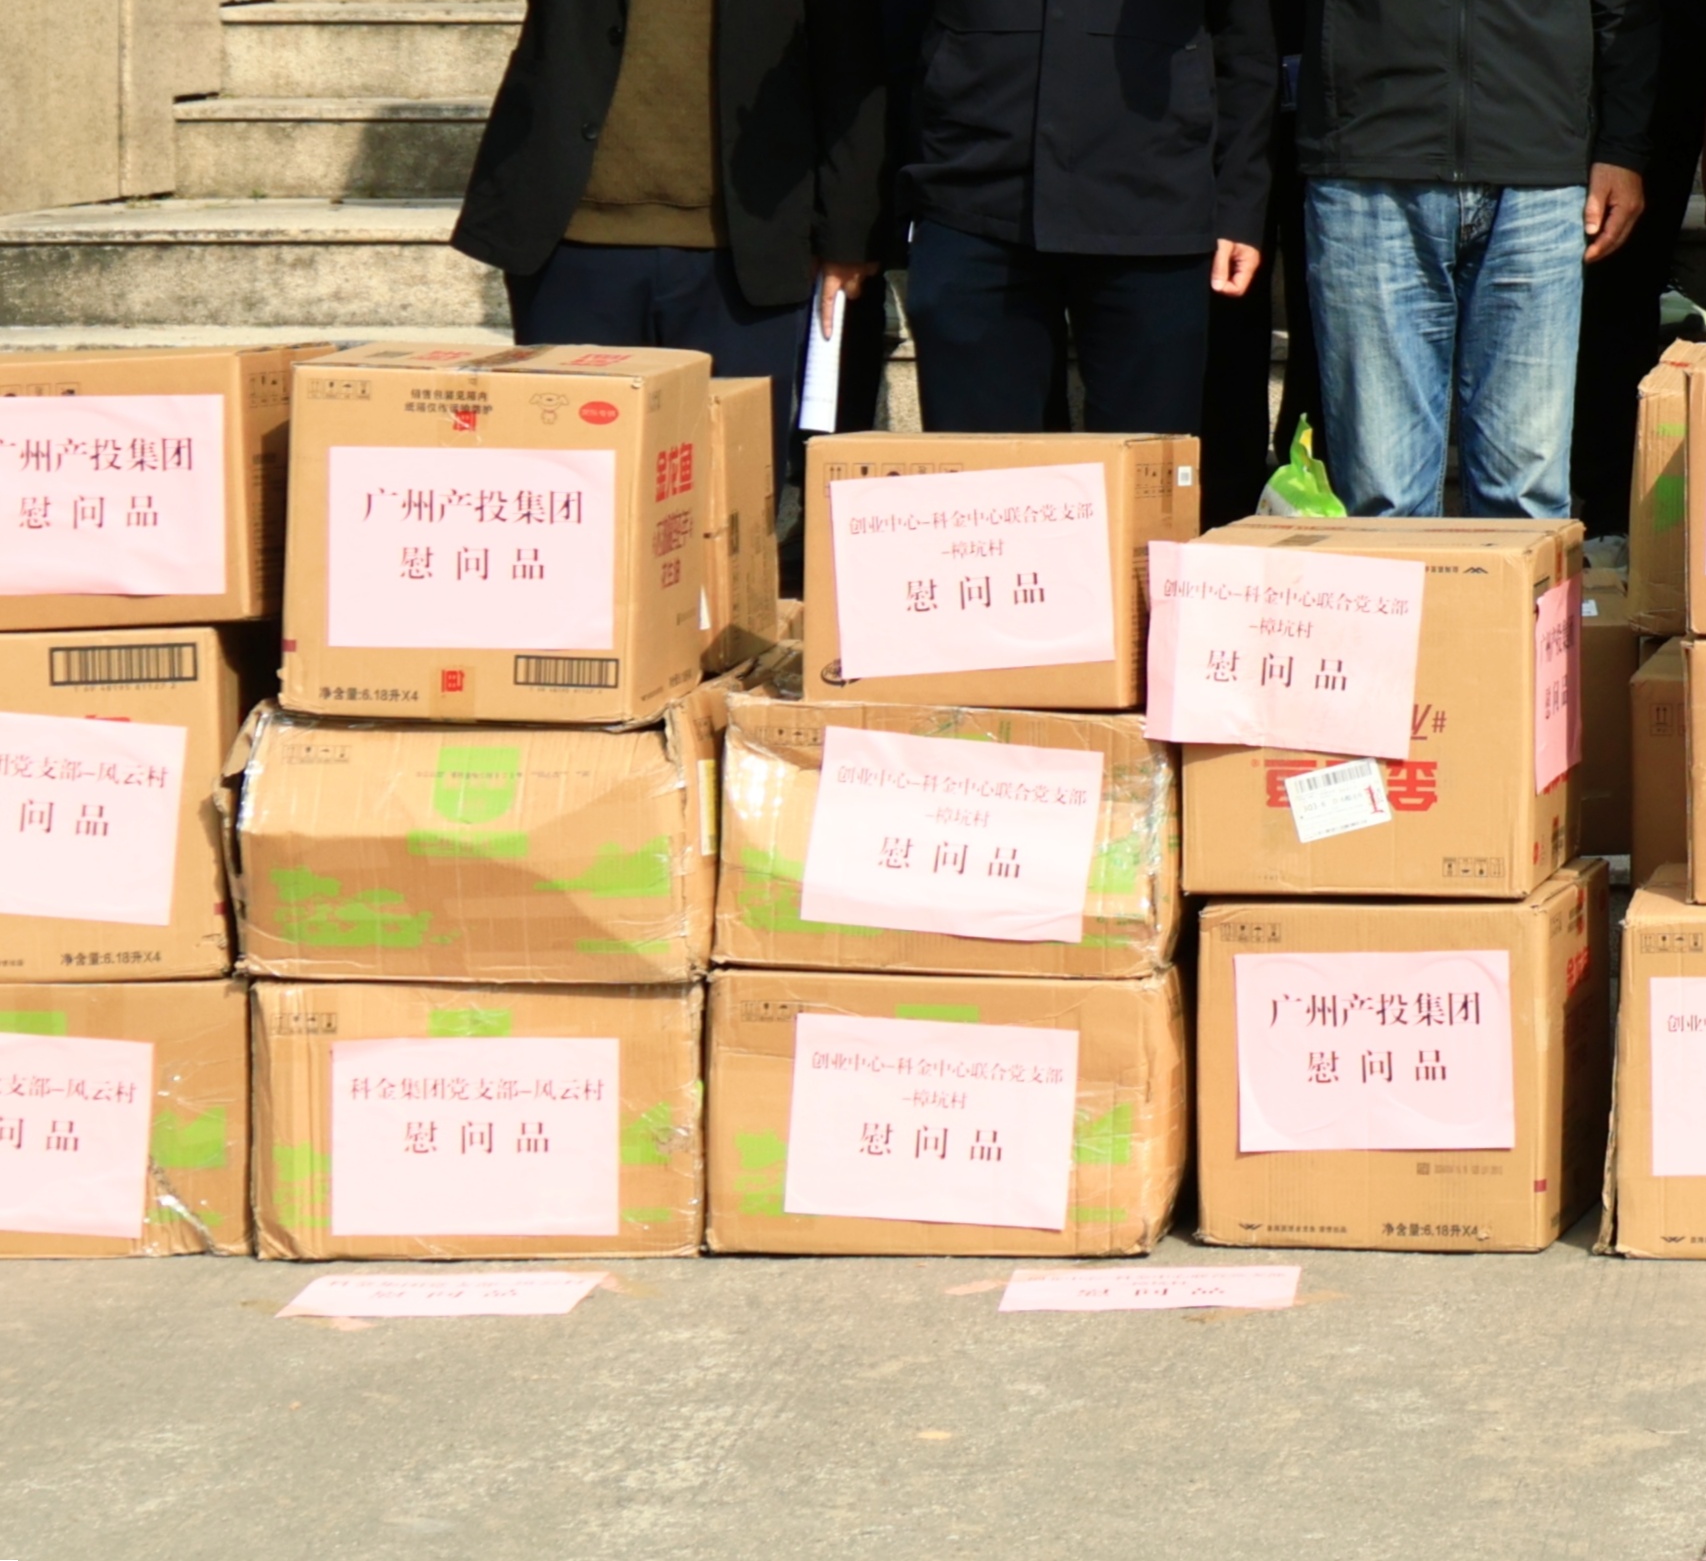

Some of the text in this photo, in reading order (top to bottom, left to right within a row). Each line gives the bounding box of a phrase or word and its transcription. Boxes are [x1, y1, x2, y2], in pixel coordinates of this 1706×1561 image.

[656, 442, 694, 502] 金龙鱼
[18, 494, 159, 531] 慰问品
[364, 487, 583, 526] 广州产投集团
[848, 501, 1095, 536] 创业中心-科金中心联合党支部
[400, 545, 545, 582] 慰问品
[940, 537, 1006, 560] -樟坑村
[906, 571, 1046, 613] 慰问品
[1162, 576, 1411, 618] 创业中心-科金中心联合党支部
[1248, 616, 1315, 640] -樟坑村
[1205, 649, 1348, 692] 慰问品
[319, 687, 420, 703] 净含量:6.18升X4
[836, 758, 1088, 807] 创业中心-科金中心联合党支部
[925, 806, 992, 829] -樟坑村
[877, 836, 1021, 880] 慰问品
[1270, 991, 1481, 1028] 广州产投集团
[810, 1049, 1065, 1085] 创业中心-科金中心联合党支部
[1307, 1049, 1447, 1085] 慰问品
[0, 1073, 138, 1105] 支部-风云村
[349, 1076, 605, 1102] 科金集团党支部-风云村
[901, 1088, 969, 1111] -樟坑村
[404, 1120, 550, 1156] 慰问品
[859, 1122, 1003, 1163] 慰问品
[1381, 1222, 1478, 1238] 净含量:6.18升X4
